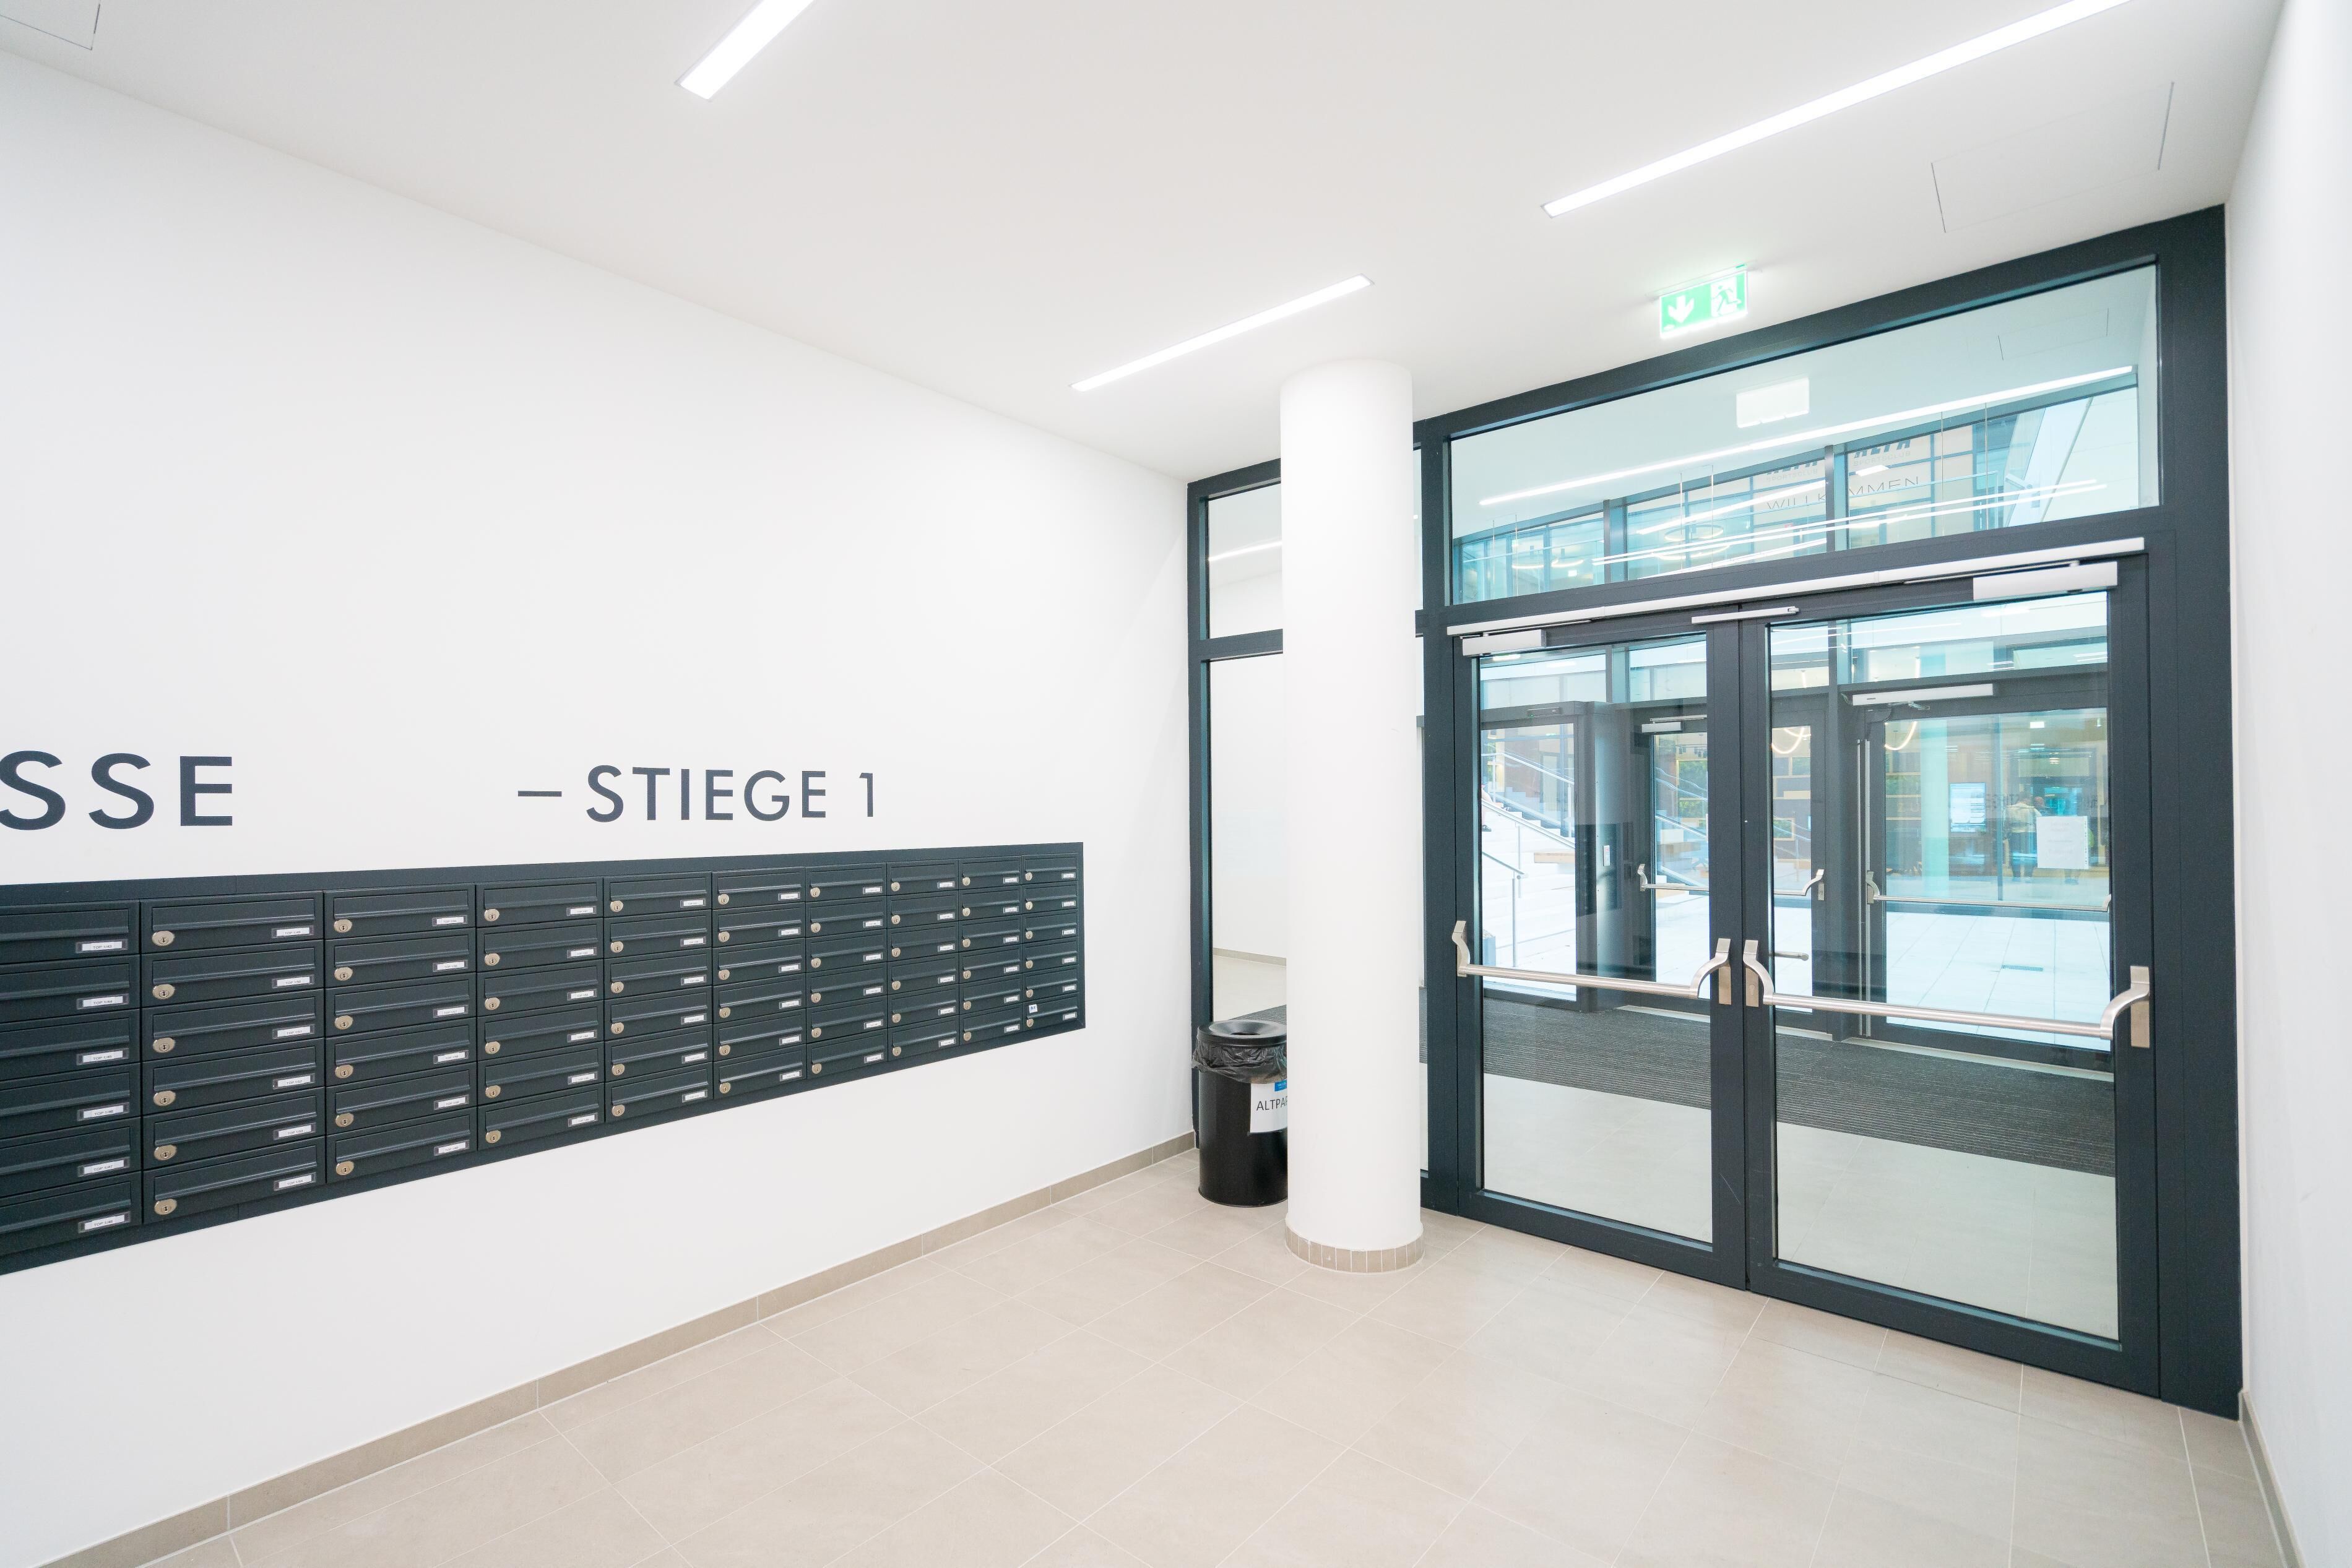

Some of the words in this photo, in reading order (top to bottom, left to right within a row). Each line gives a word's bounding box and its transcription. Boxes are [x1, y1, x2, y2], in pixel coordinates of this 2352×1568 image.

[0, 751, 232, 830] SSE
[587, 765, 826, 822] STIEGE
[860, 773, 873, 817] 1
